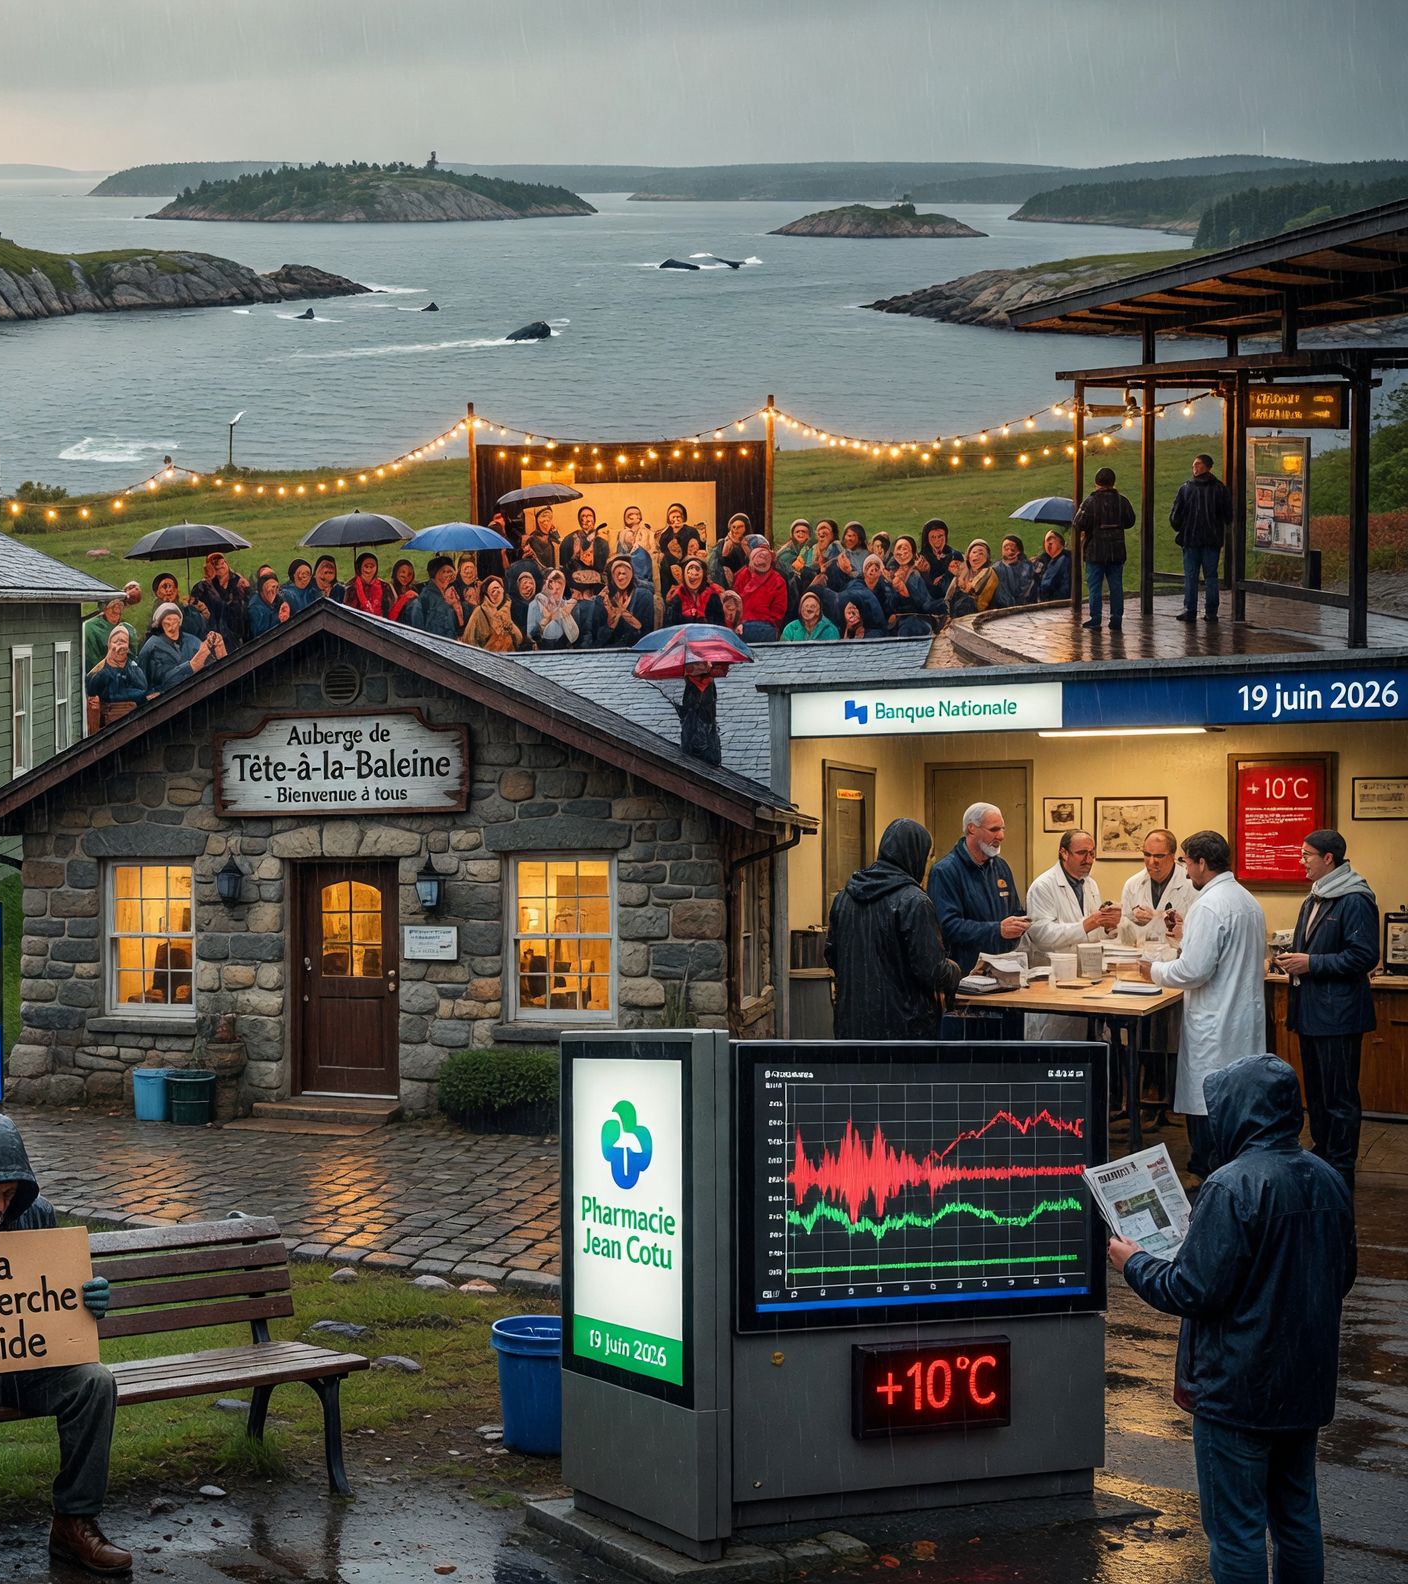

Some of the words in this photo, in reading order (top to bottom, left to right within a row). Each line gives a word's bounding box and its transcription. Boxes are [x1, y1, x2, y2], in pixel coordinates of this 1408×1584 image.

[875, 702, 935, 723] Banque
[938, 699, 1017, 717] Nationale
[1238, 685, 1268, 711] 19
[1272, 682, 1322, 718] juin
[1330, 680, 1399, 709] 2026
[287, 723, 363, 751] Auberge
[369, 723, 391, 743] de
[232, 749, 451, 782] Tête-à-la-Baleine
[277, 787, 357, 803] Bienvenue
[361, 786, 370, 801] à
[375, 786, 408, 801] tous
[581, 1195, 676, 1236] Pharmacie
[583, 1228, 622, 1260] Jean
[626, 1235, 672, 1270] Cotu
[876, 1355, 996, 1410] +10°C
